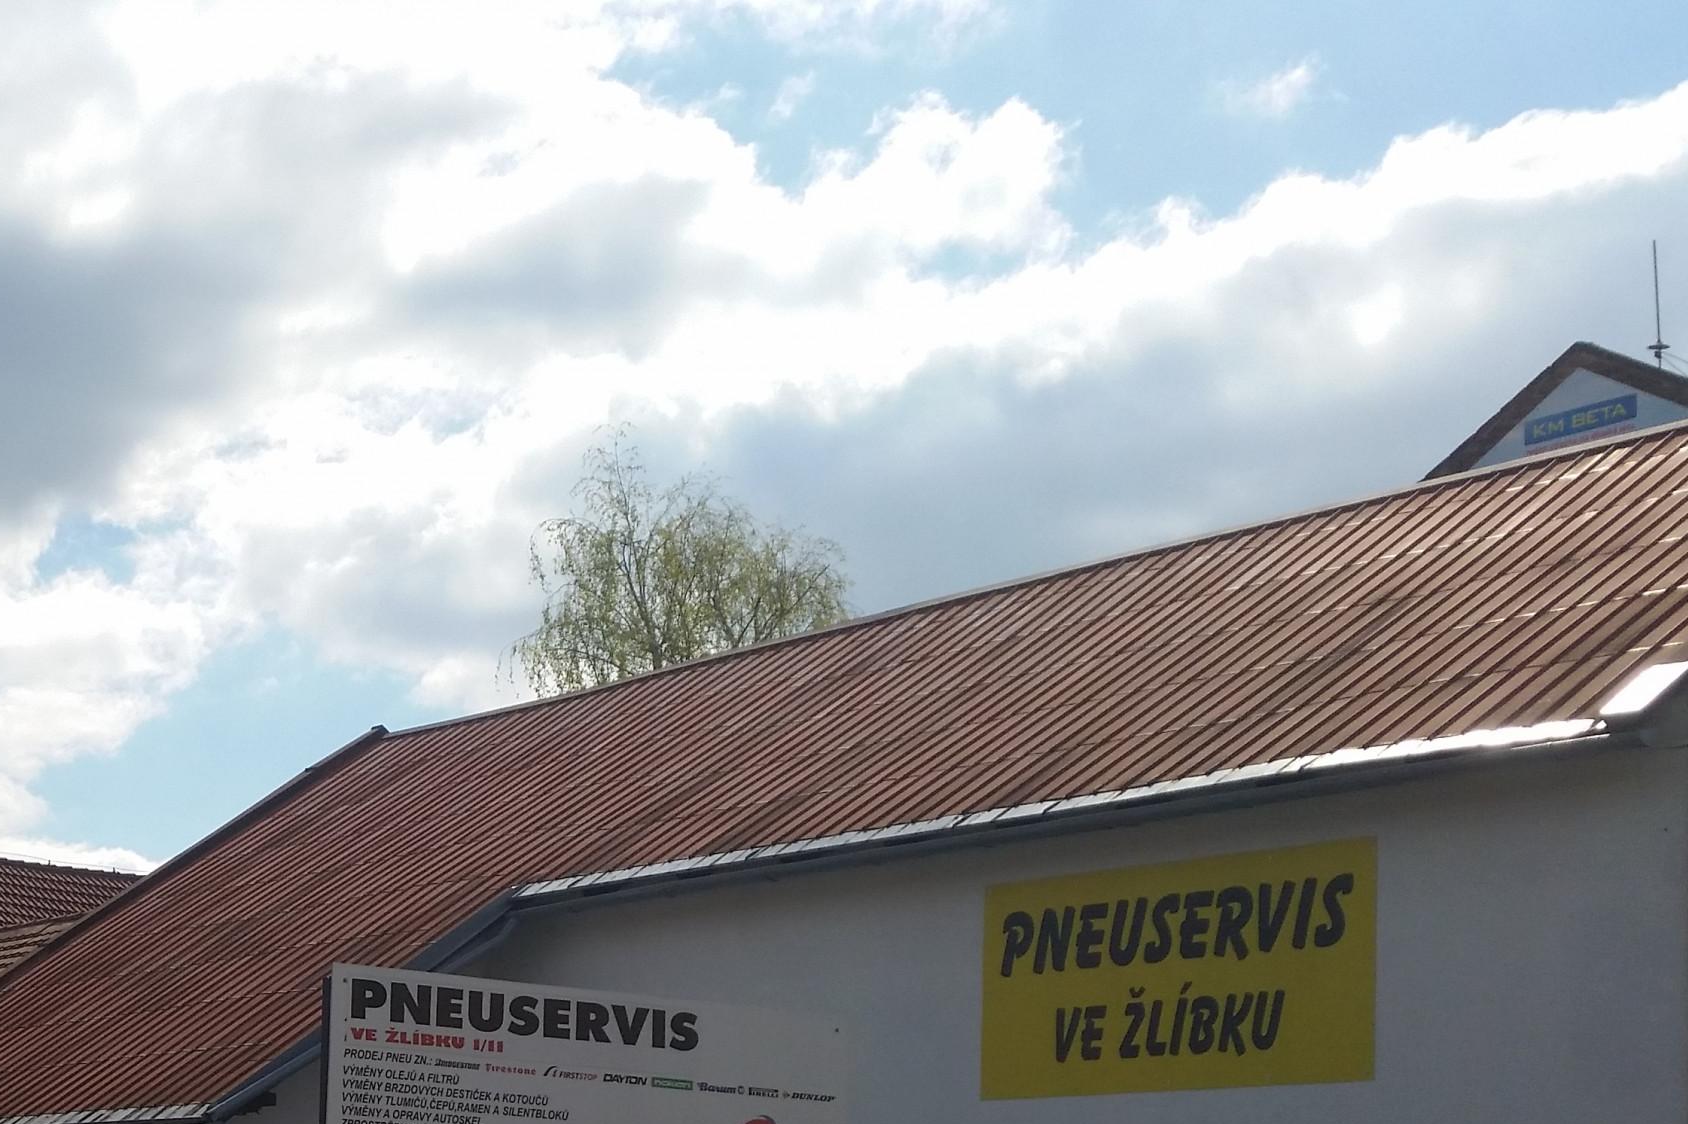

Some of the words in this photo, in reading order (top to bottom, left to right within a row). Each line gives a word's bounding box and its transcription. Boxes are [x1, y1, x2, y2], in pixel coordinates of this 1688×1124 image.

[1533, 418, 1565, 439] KM
[1572, 403, 1627, 428] BETA
[1000, 873, 1354, 977] PNEUSERVIS
[350, 978, 699, 1051] PNEUSERVIS
[1055, 1004, 1108, 1063] VE
[1119, 981, 1286, 1059] ŽLÍBKU
[350, 1027, 377, 1042] VE
[385, 1027, 465, 1049] ŽLÍBKU
[342, 1078, 383, 1092] VÝMĚNY
[446, 1087, 492, 1102] DESTIČEK
[494, 1092, 500, 1102] A
[343, 1064, 383, 1078] VÝMĚNY
[385, 1069, 416, 1081] OLEJŮ
[418, 1073, 425, 1082] A
[427, 1073, 460, 1086] FILTRŮ
[343, 1048, 384, 1061] PRODEJ
[385, 1052, 412, 1064] PNEU
[603, 1073, 647, 1086] DAYTON
[792, 1092, 836, 1103] DUNLOP
[341, 1104, 382, 1118] VÝMĚNY
[383, 1109, 390, 1118] A
[392, 1109, 432, 1122] OPRAVY
[342, 1091, 382, 1105] VÝMĚNY
[493, 1105, 500, 1115] A
